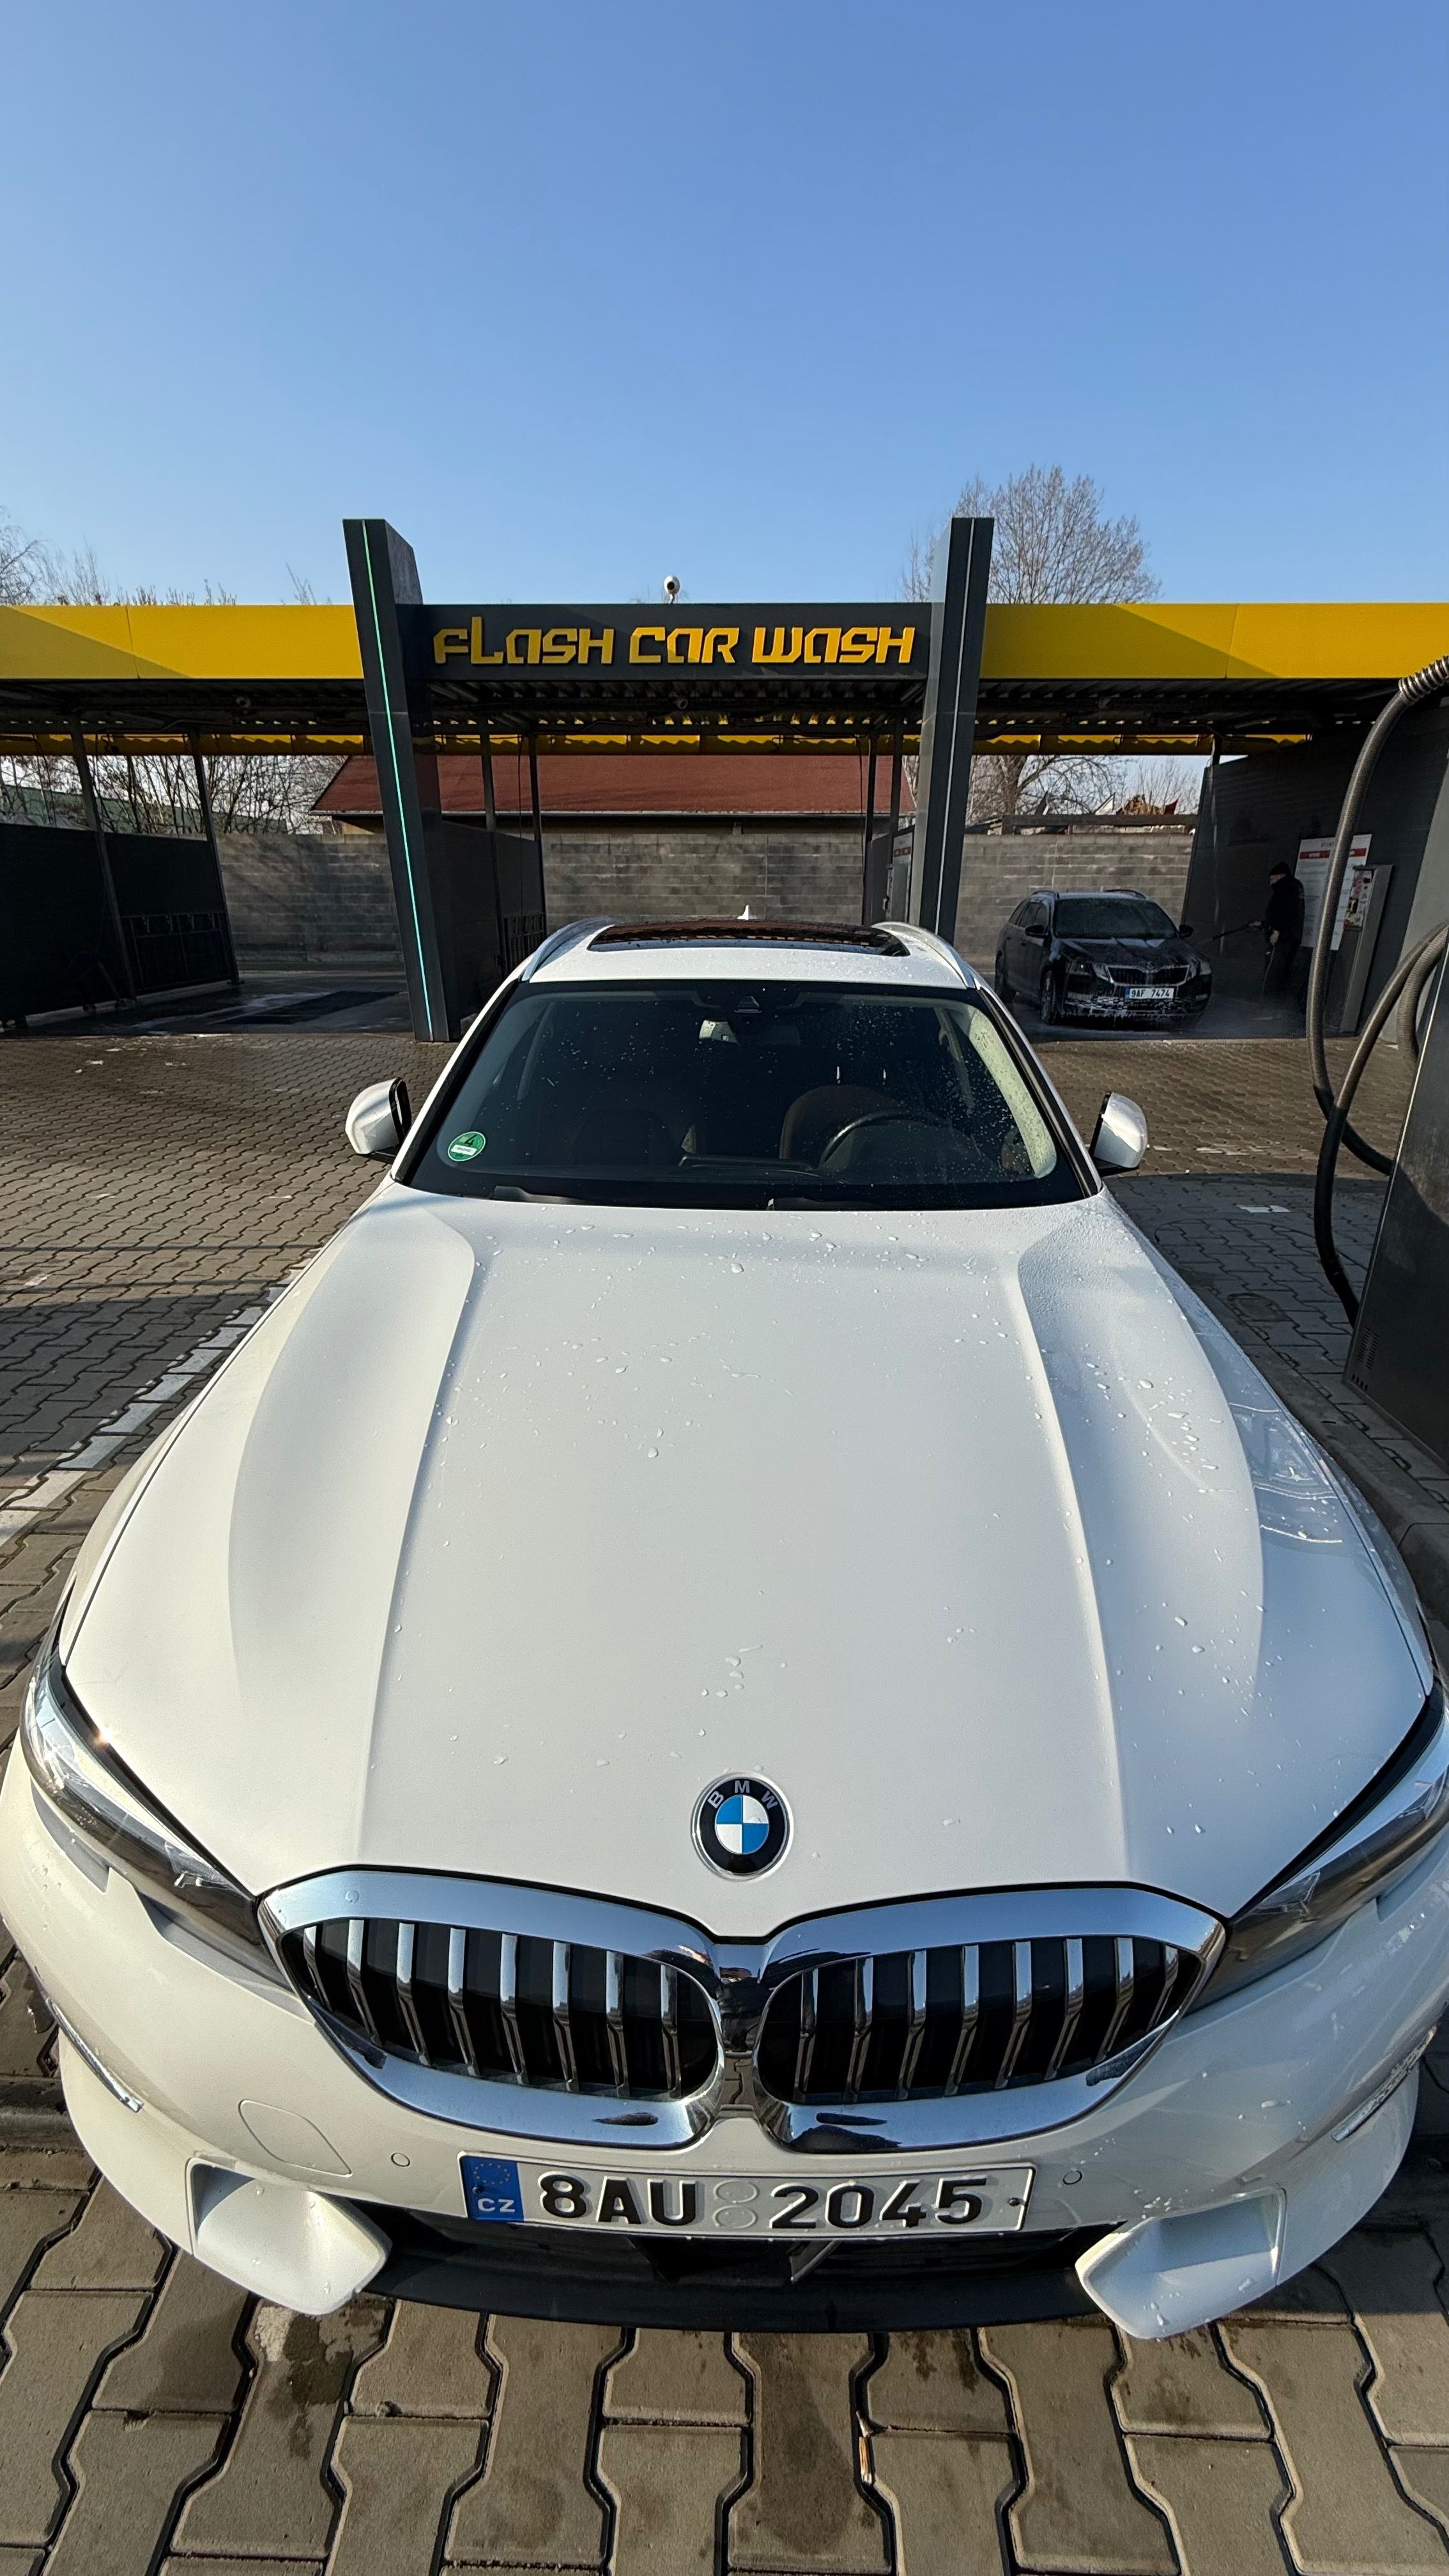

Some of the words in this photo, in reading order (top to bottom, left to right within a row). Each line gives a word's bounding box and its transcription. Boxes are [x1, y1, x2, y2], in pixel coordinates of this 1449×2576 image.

[629, 625, 740, 664] CAR
[751, 625, 916, 664] WASH
[1131, 989, 1146, 997] 9AF
[1151, 989, 1170, 997] 7474
[707, 1780, 779, 1809] BMW
[477, 2197, 516, 2214] CZ
[538, 2172, 698, 2227] 8AU
[770, 2177, 988, 2230] 2045
